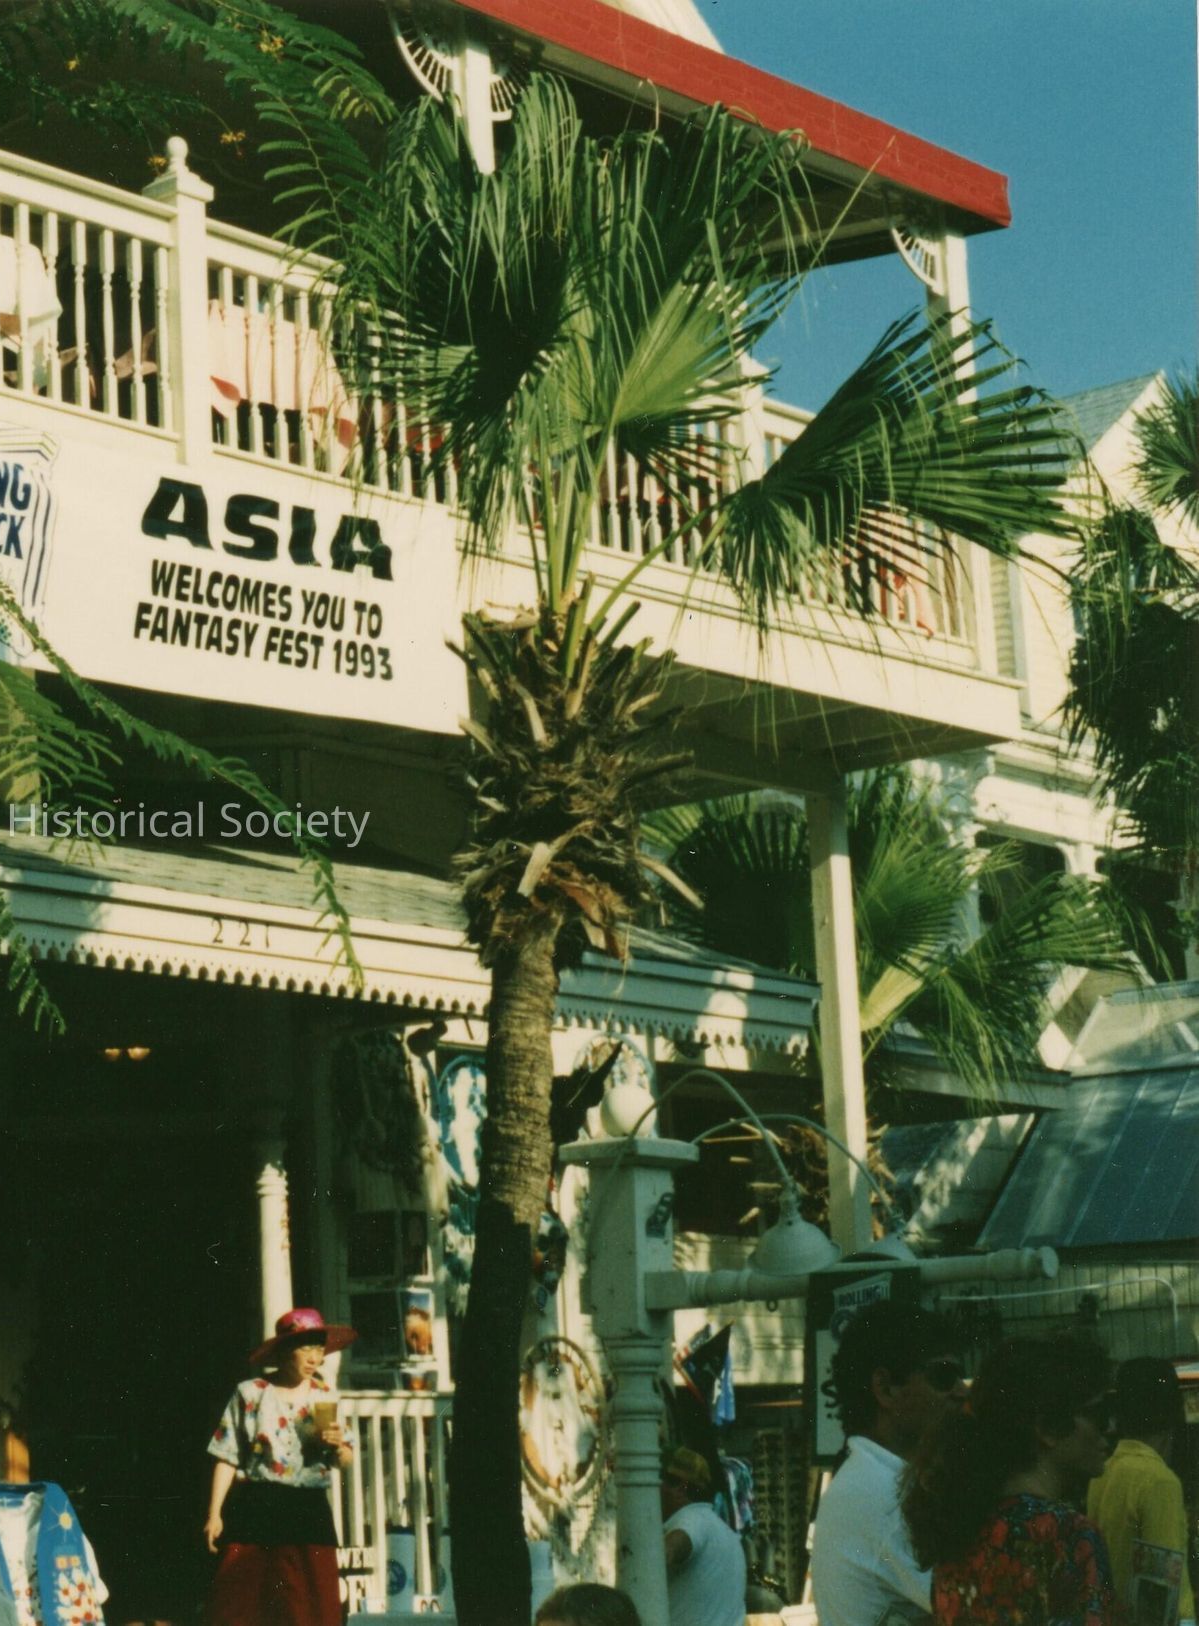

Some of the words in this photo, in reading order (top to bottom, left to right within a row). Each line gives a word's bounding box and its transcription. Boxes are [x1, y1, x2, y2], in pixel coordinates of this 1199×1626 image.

[141, 476, 394, 581] ASIA
[151, 559, 293, 622] WELCOMES
[301, 589, 345, 632] YOU
[354, 600, 383, 639] TO
[133, 601, 260, 658] FANTASY
[263, 626, 325, 670] FEST
[333, 639, 393, 681] 1993
[211, 916, 272, 949] 221
